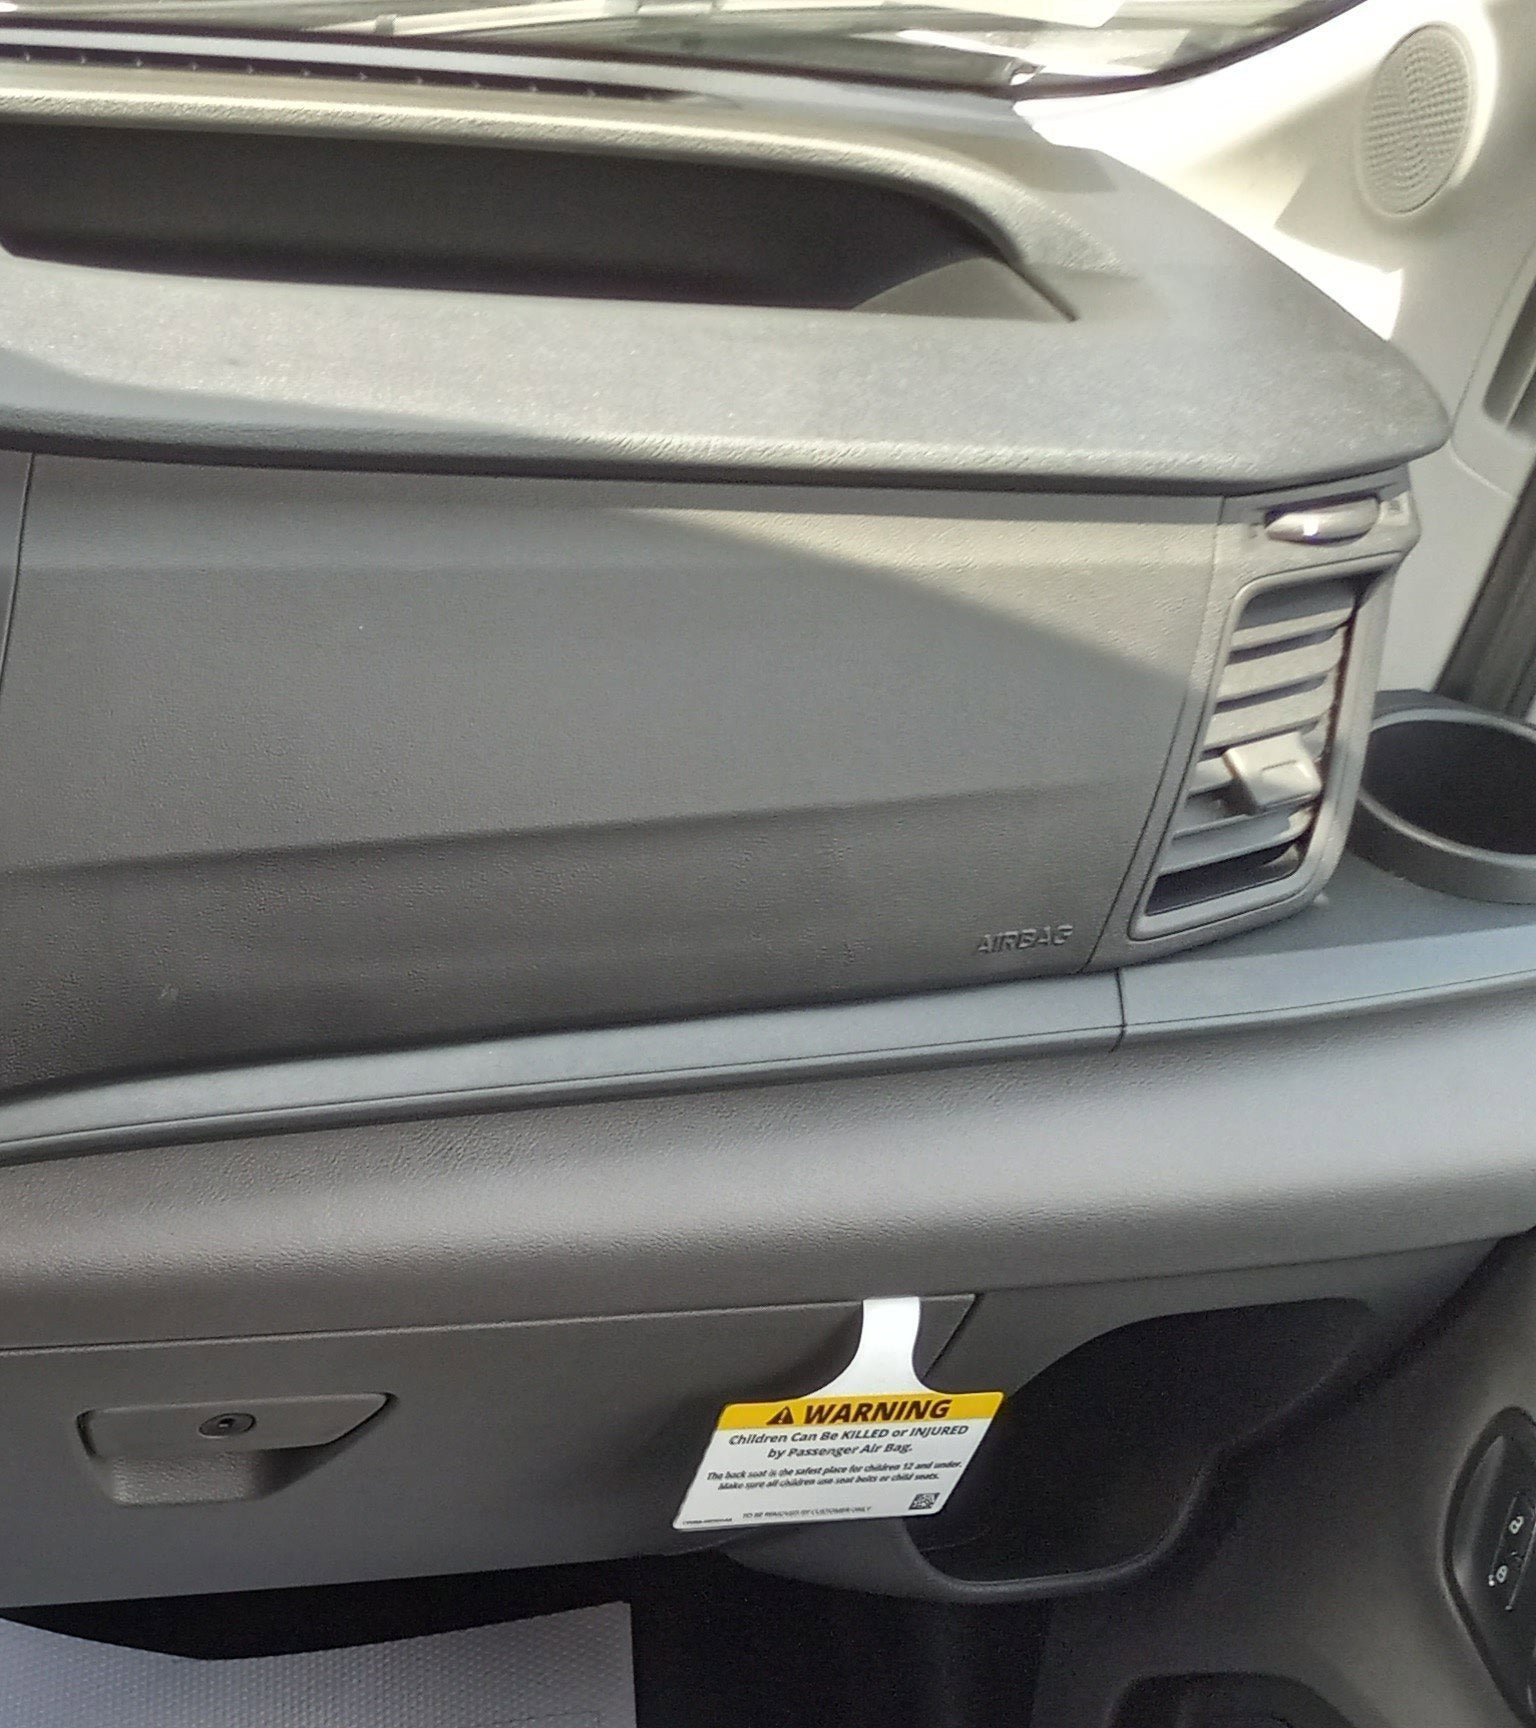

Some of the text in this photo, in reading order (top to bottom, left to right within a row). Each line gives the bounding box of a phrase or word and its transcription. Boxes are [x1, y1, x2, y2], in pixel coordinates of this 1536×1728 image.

[977, 924, 1074, 955] AIRBAG
[803, 1399, 953, 1426] WARNING
[728, 1425, 969, 1446] Children Can Be KILLED or INJURED
[767, 1448, 787, 1460] by
[788, 1446, 859, 1458] Passenger
[859, 1443, 883, 1454] Air
